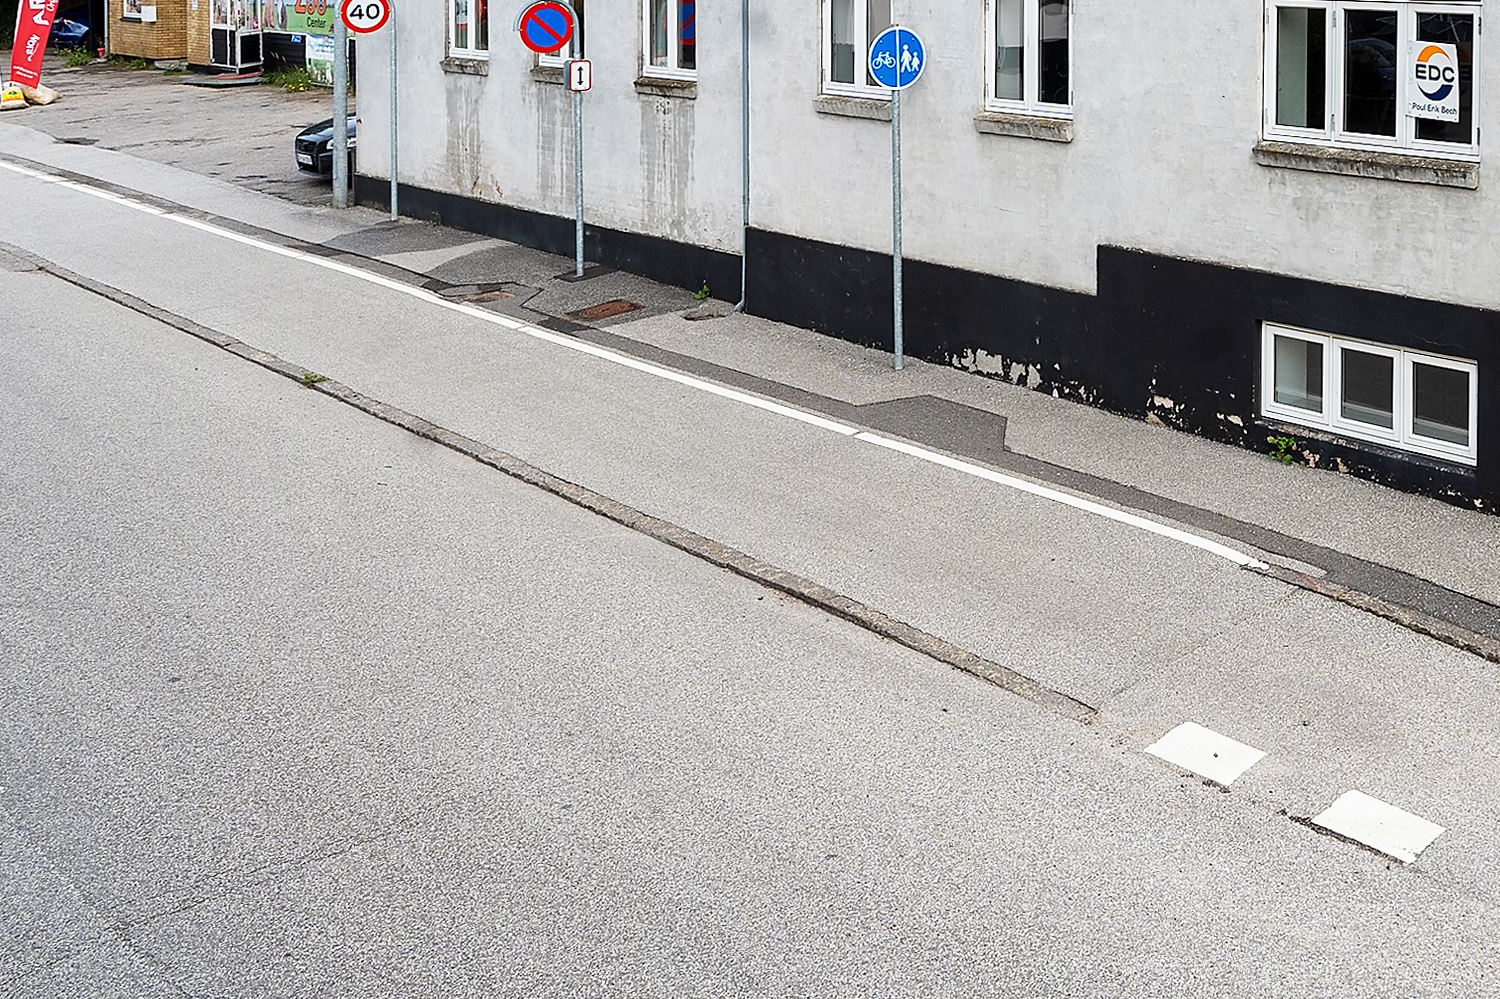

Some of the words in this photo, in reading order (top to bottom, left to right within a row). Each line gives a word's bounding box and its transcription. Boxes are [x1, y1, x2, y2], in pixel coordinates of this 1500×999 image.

[349, 3, 380, 20] 40
[306, 16, 327, 29] Center
[1415, 63, 1455, 83] EDC
[1412, 102, 1426, 111] Poul
[1427, 103, 1440, 113] Erik
